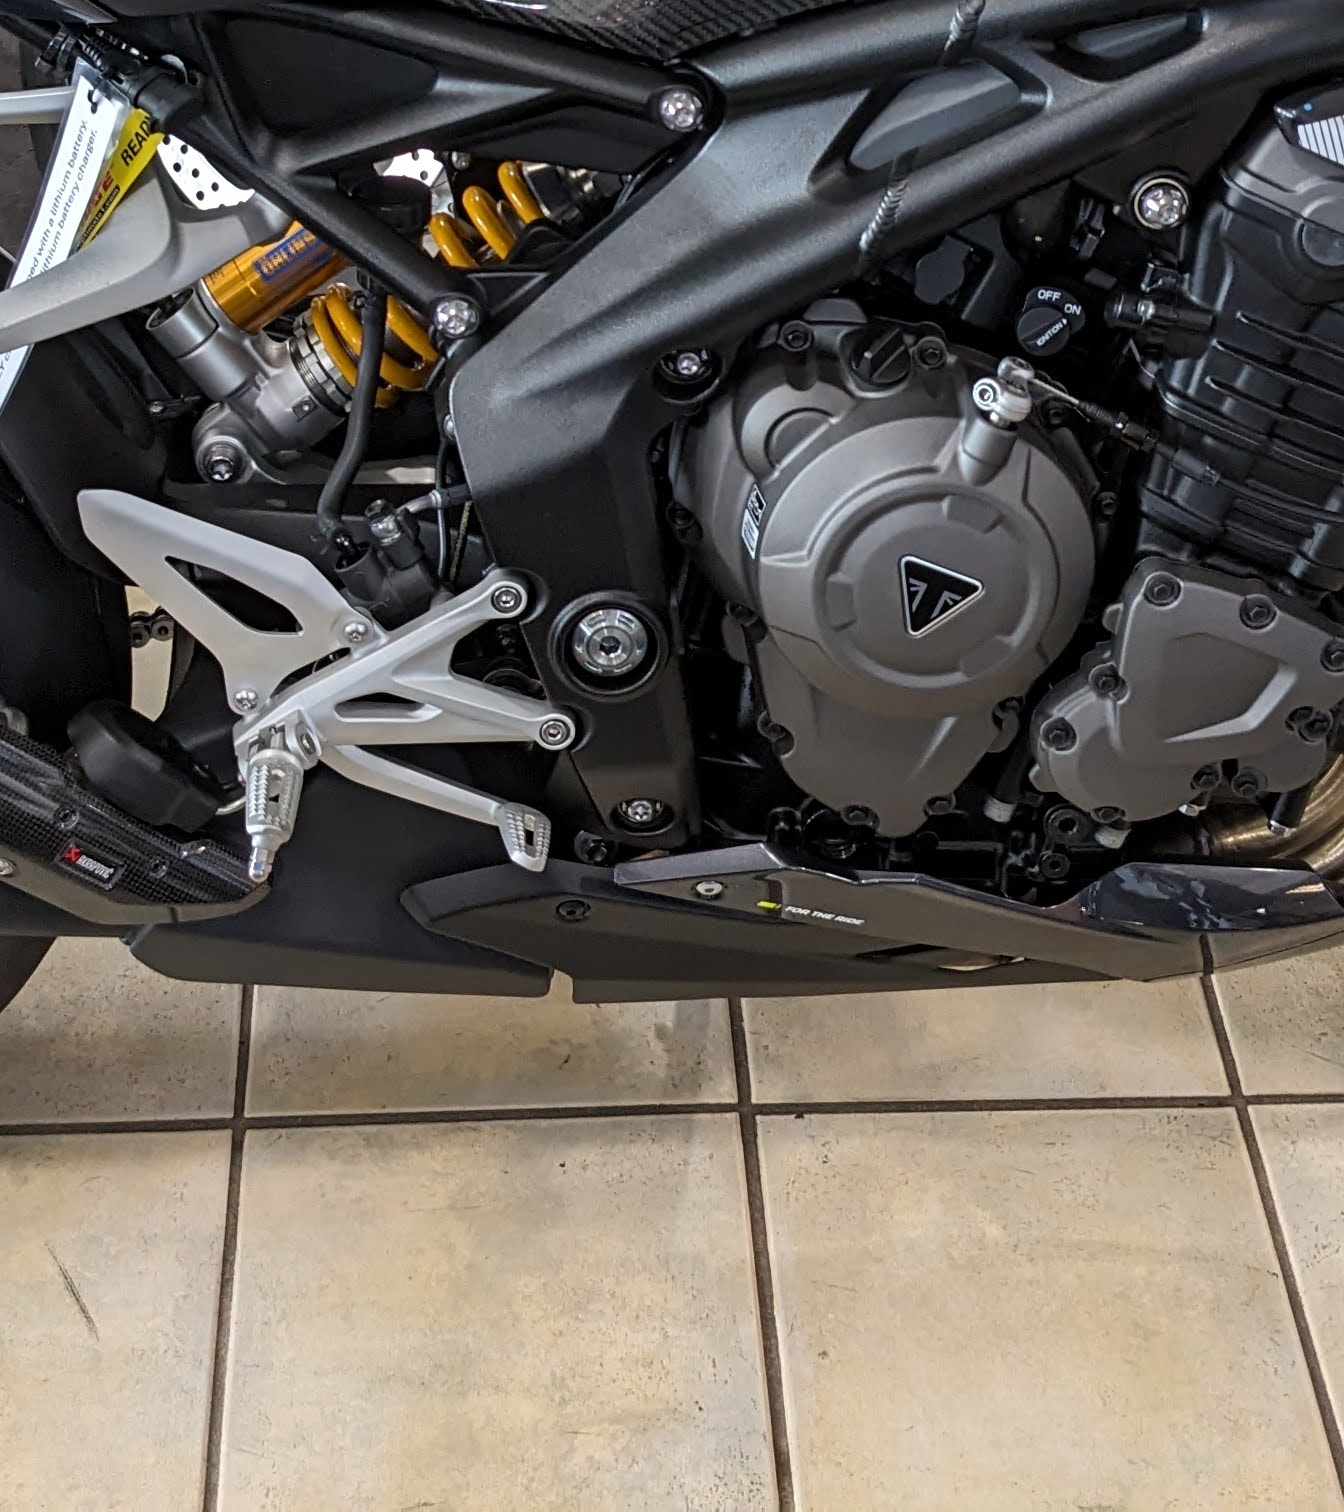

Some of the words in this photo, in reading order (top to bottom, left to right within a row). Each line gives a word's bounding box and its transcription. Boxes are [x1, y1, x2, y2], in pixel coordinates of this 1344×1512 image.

[37, 226, 50, 256] with
[50, 171, 72, 218] lithium
[67, 119, 88, 169] battery.
[58, 183, 80, 230] battery
[76, 129, 98, 182] charger.
[1037, 289, 1061, 302] OFF
[1064, 303, 1082, 316] ON
[1036, 321, 1063, 346] IGNITION
[784, 905, 811, 915] FOR
[811, 910, 835, 920] THE
[834, 915, 865, 925] RIDE
